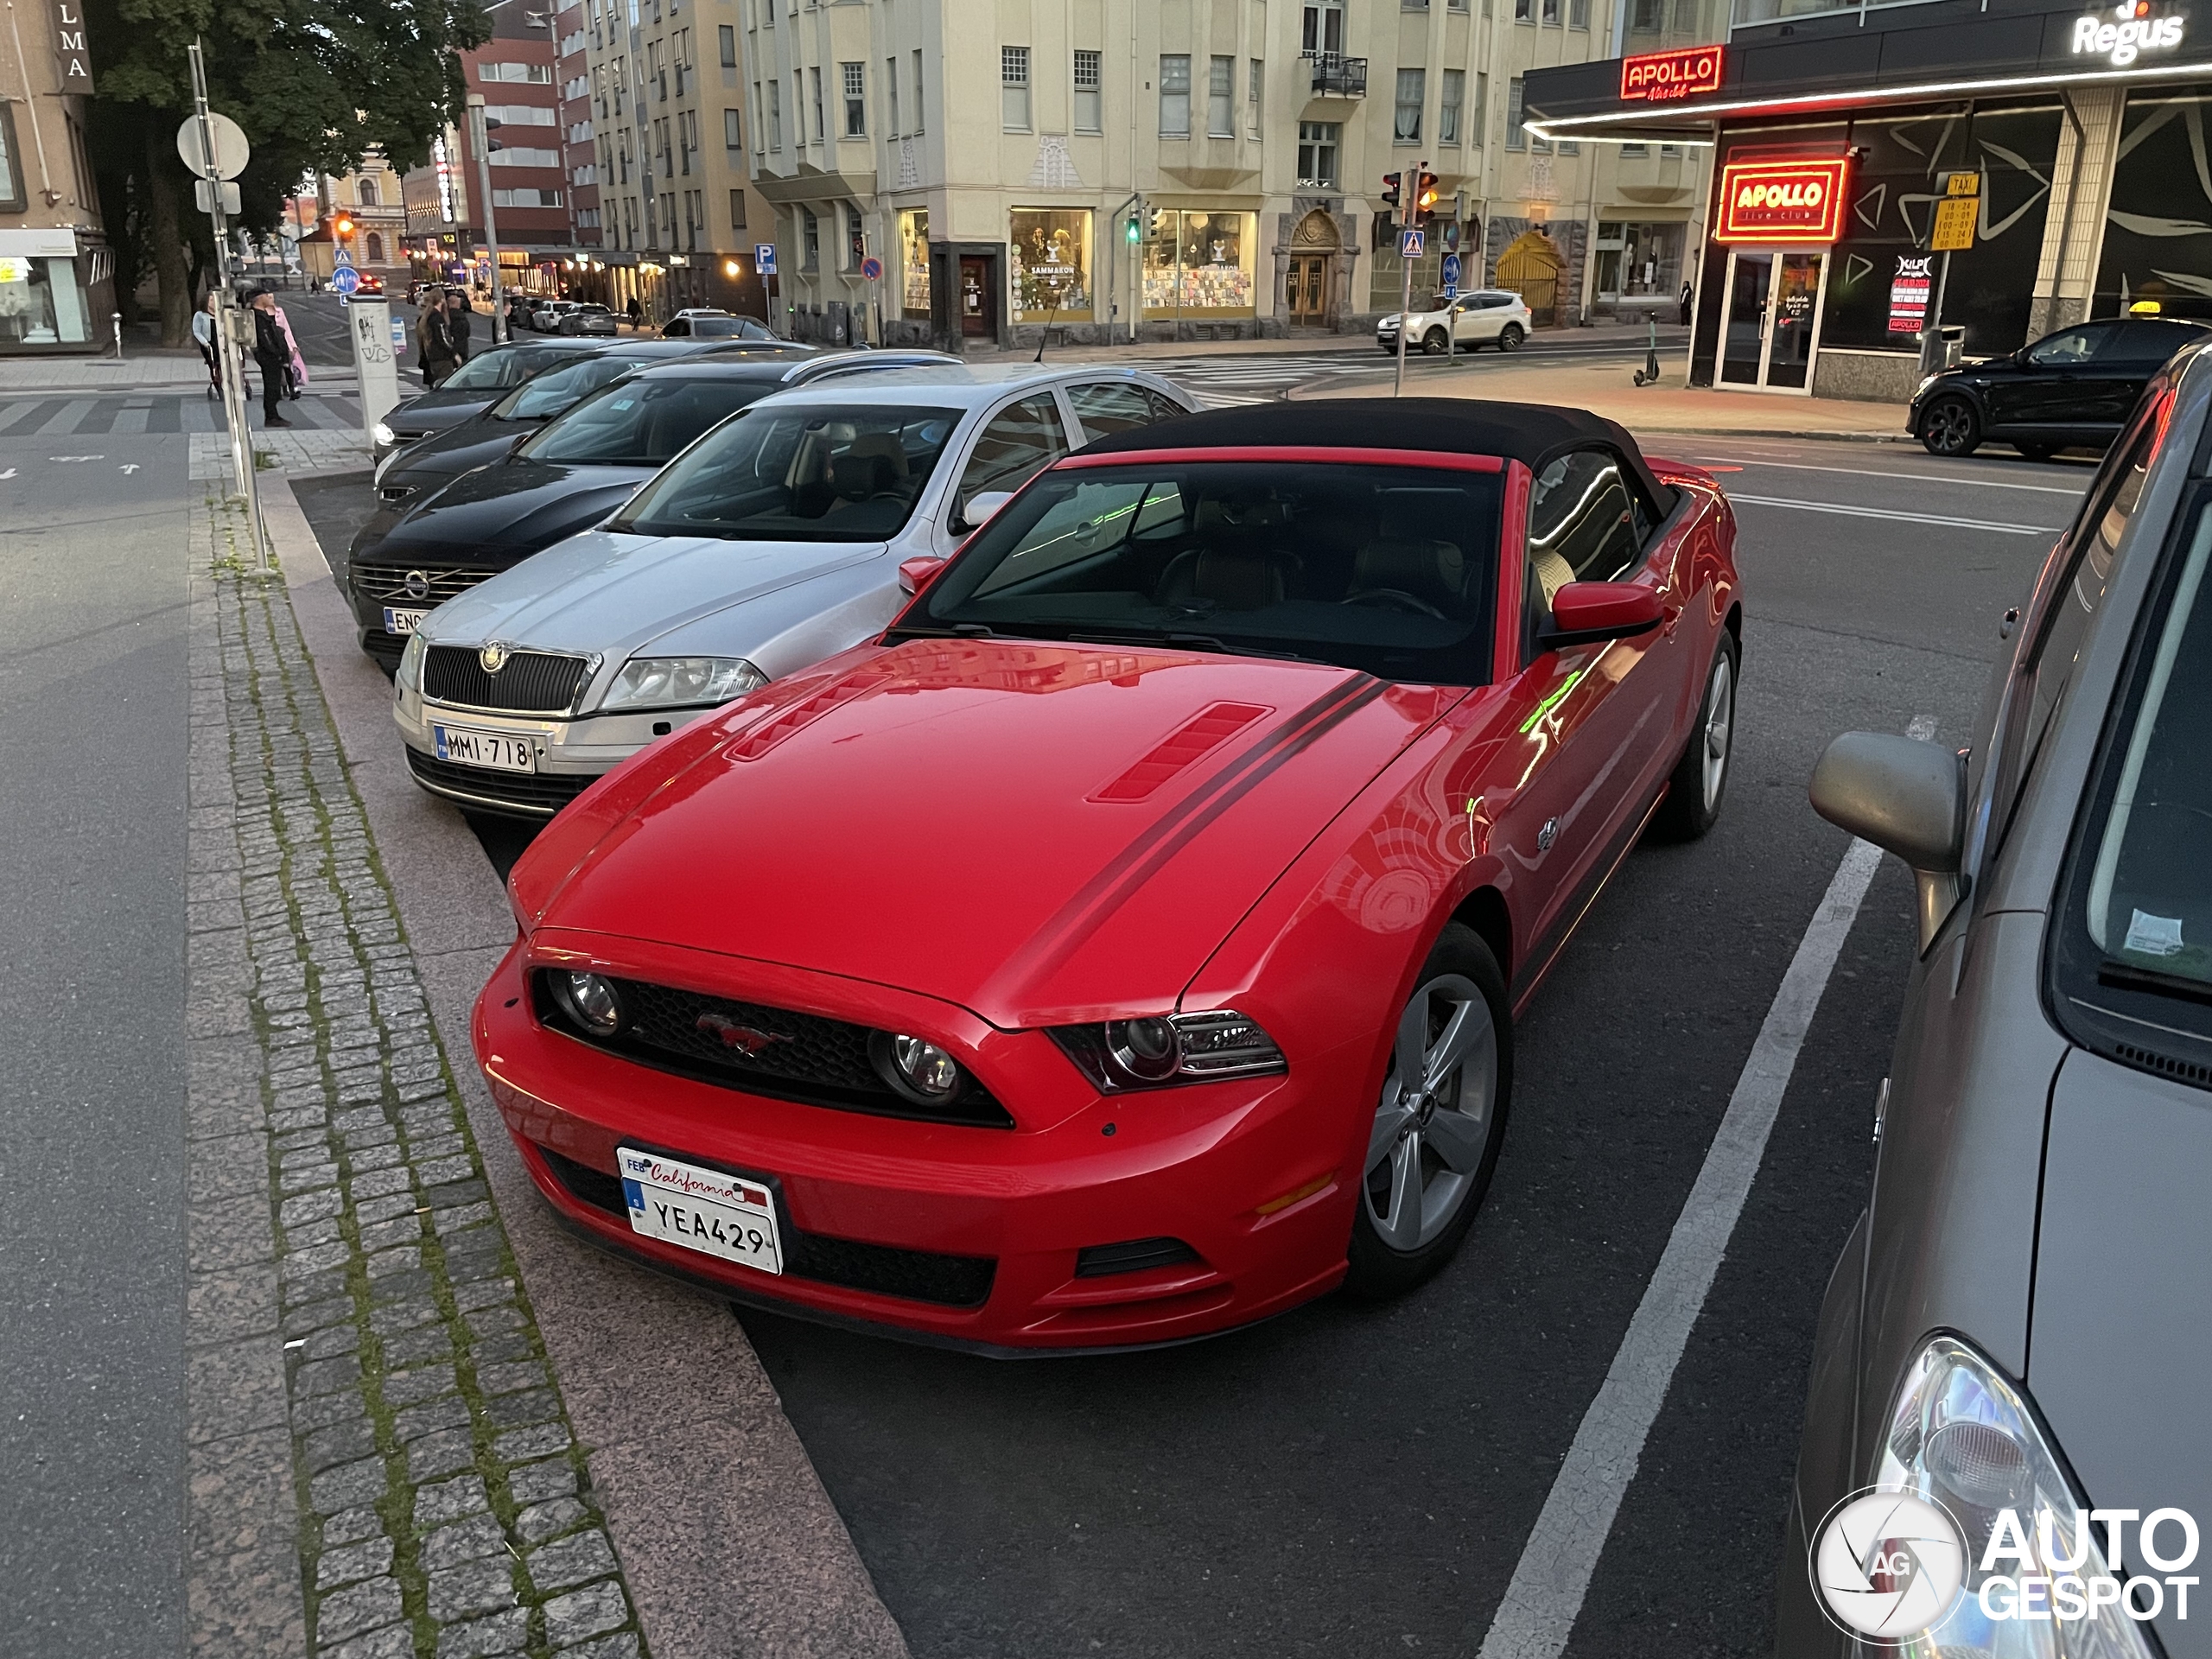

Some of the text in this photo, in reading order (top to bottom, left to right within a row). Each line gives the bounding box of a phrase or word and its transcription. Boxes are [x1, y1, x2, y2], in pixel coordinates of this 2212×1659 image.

[60, 4, 86, 76] LMA
[2073, 16, 2183, 66] Regus
[1629, 57, 1712, 86] APOLLO
[1737, 182, 1822, 208] APOLLO
[1954, 179, 1973, 190] TAXI
[1745, 210, 1810, 220] live club
[760, 246, 772, 263] P
[627, 1159, 739, 1198] FEB California
[632, 1198, 765, 1254] S YEA429
